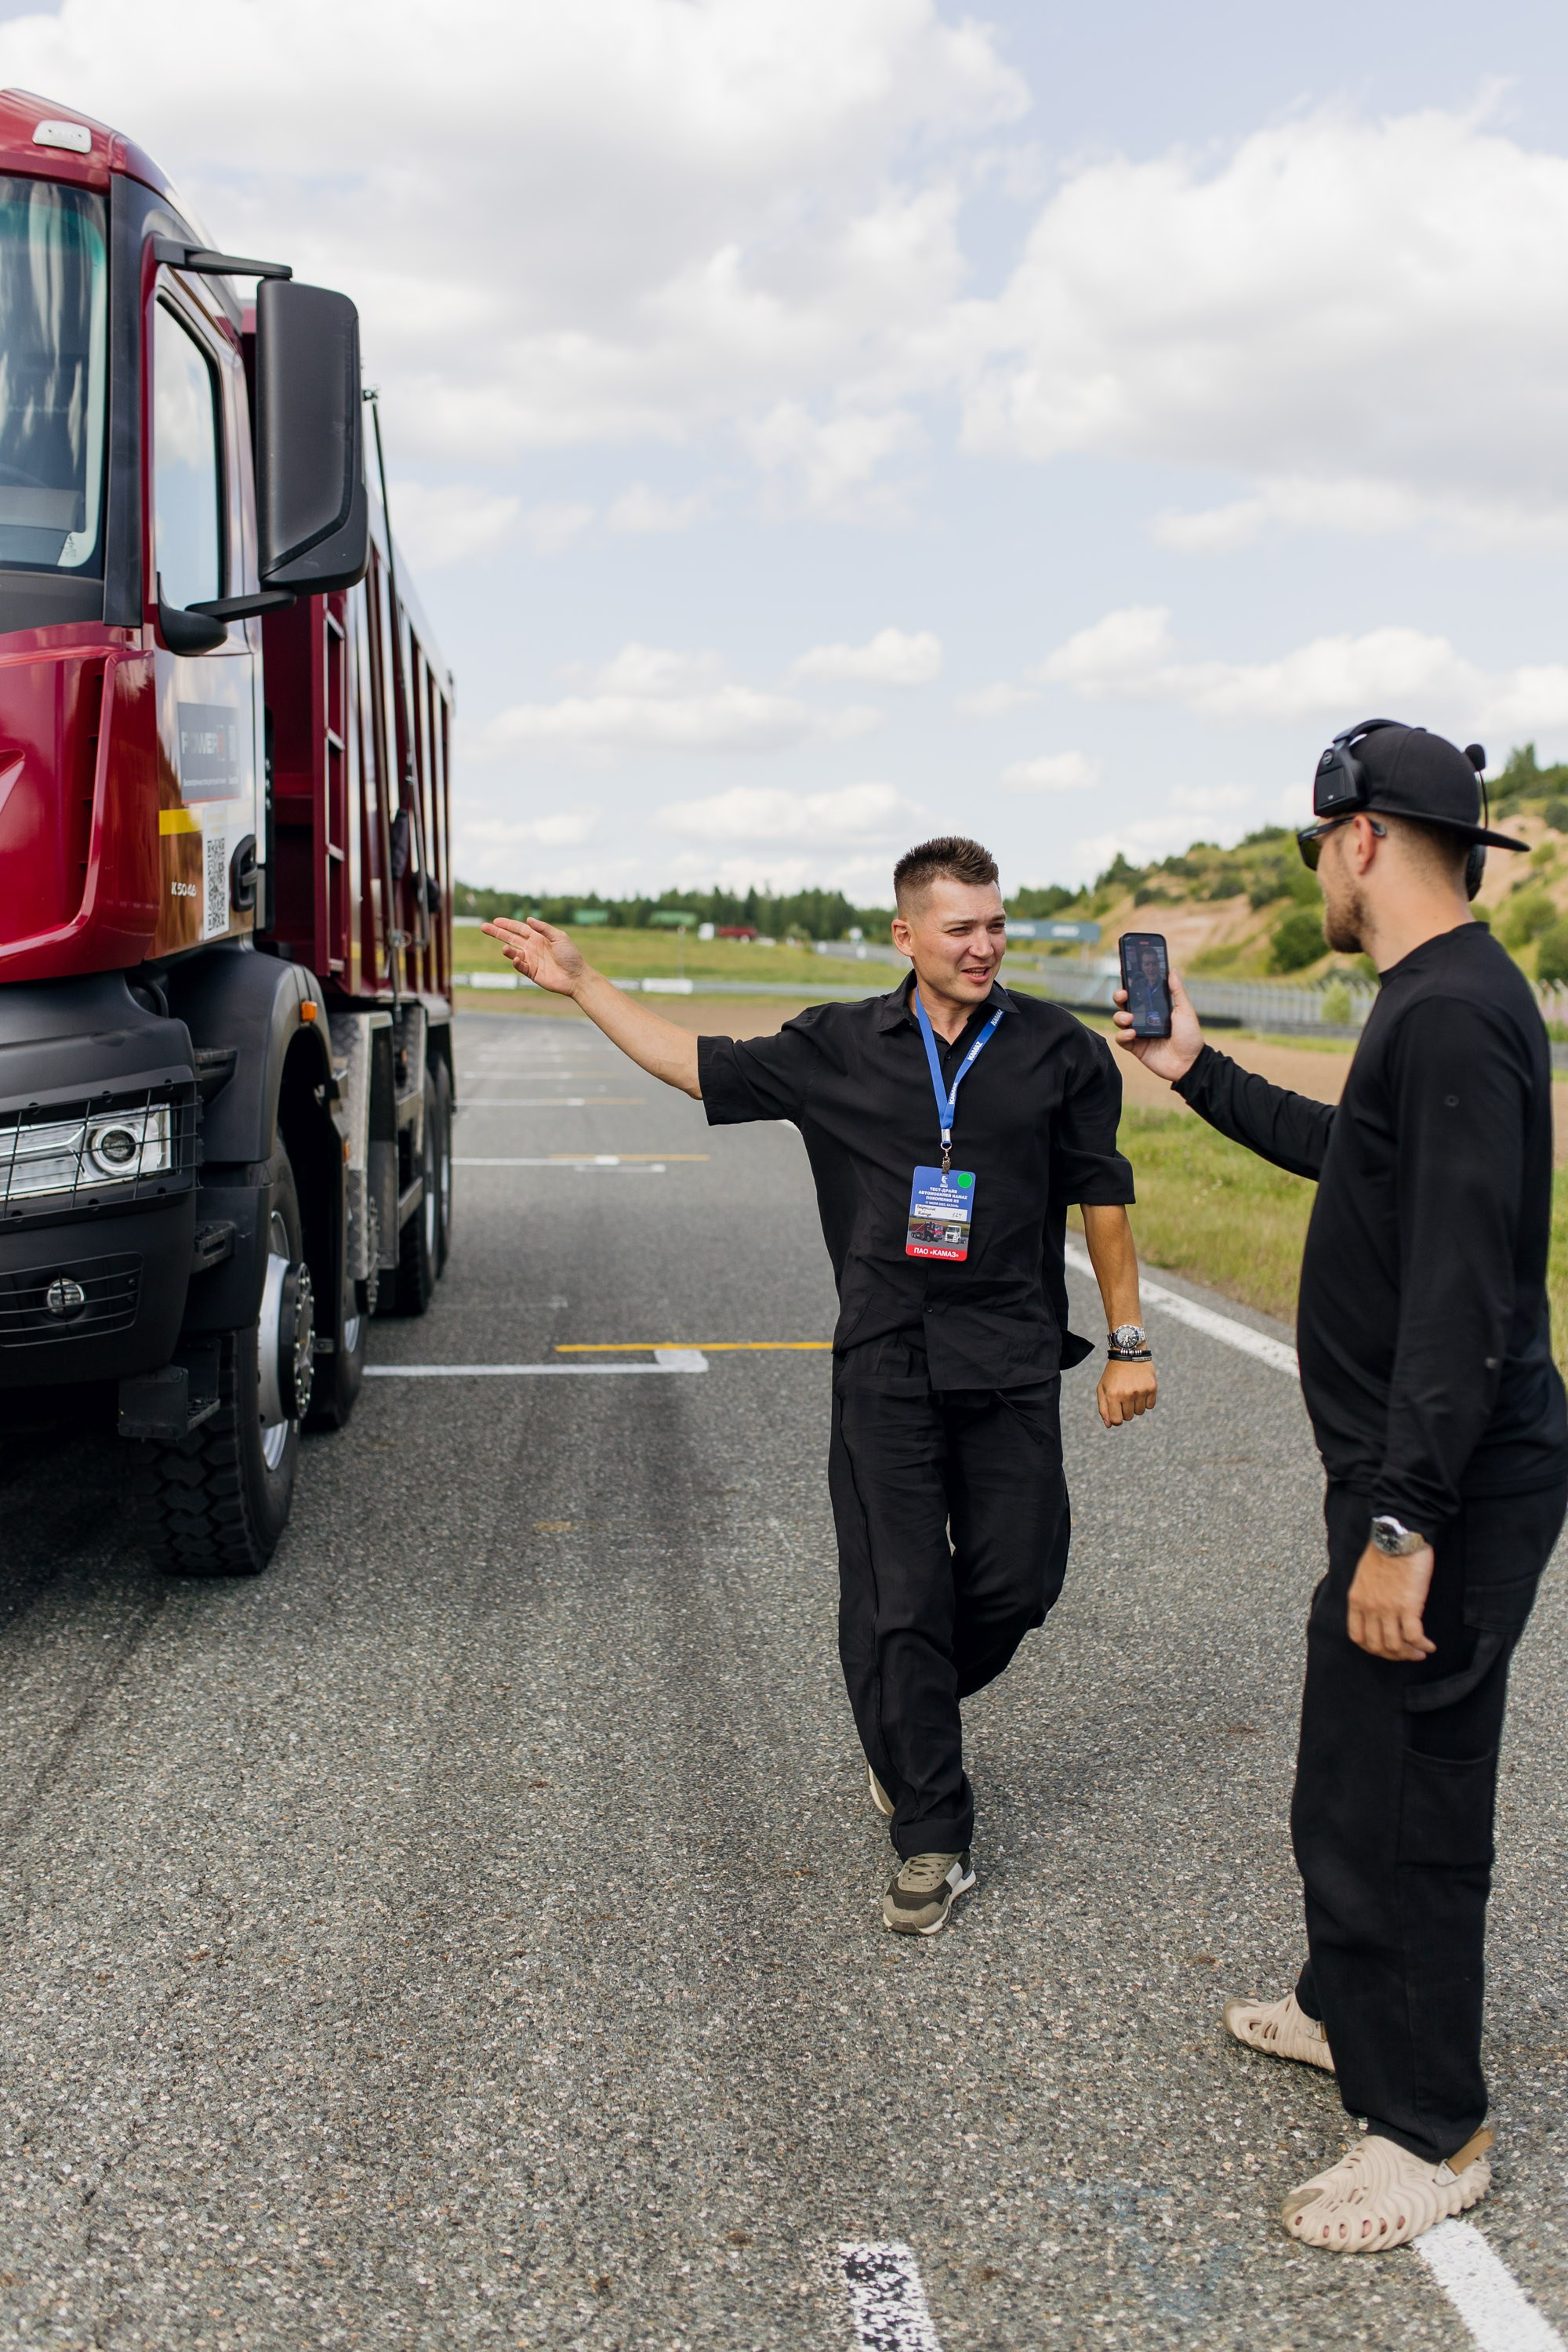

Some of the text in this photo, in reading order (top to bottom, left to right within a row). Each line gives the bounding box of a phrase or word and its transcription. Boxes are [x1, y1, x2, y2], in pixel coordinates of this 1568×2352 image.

[990, 1009, 1003, 1026] KAMAZ
[967, 1041, 983, 1061] KAMAZ
[930, 1249, 959, 1258] «КАМАЗ»
